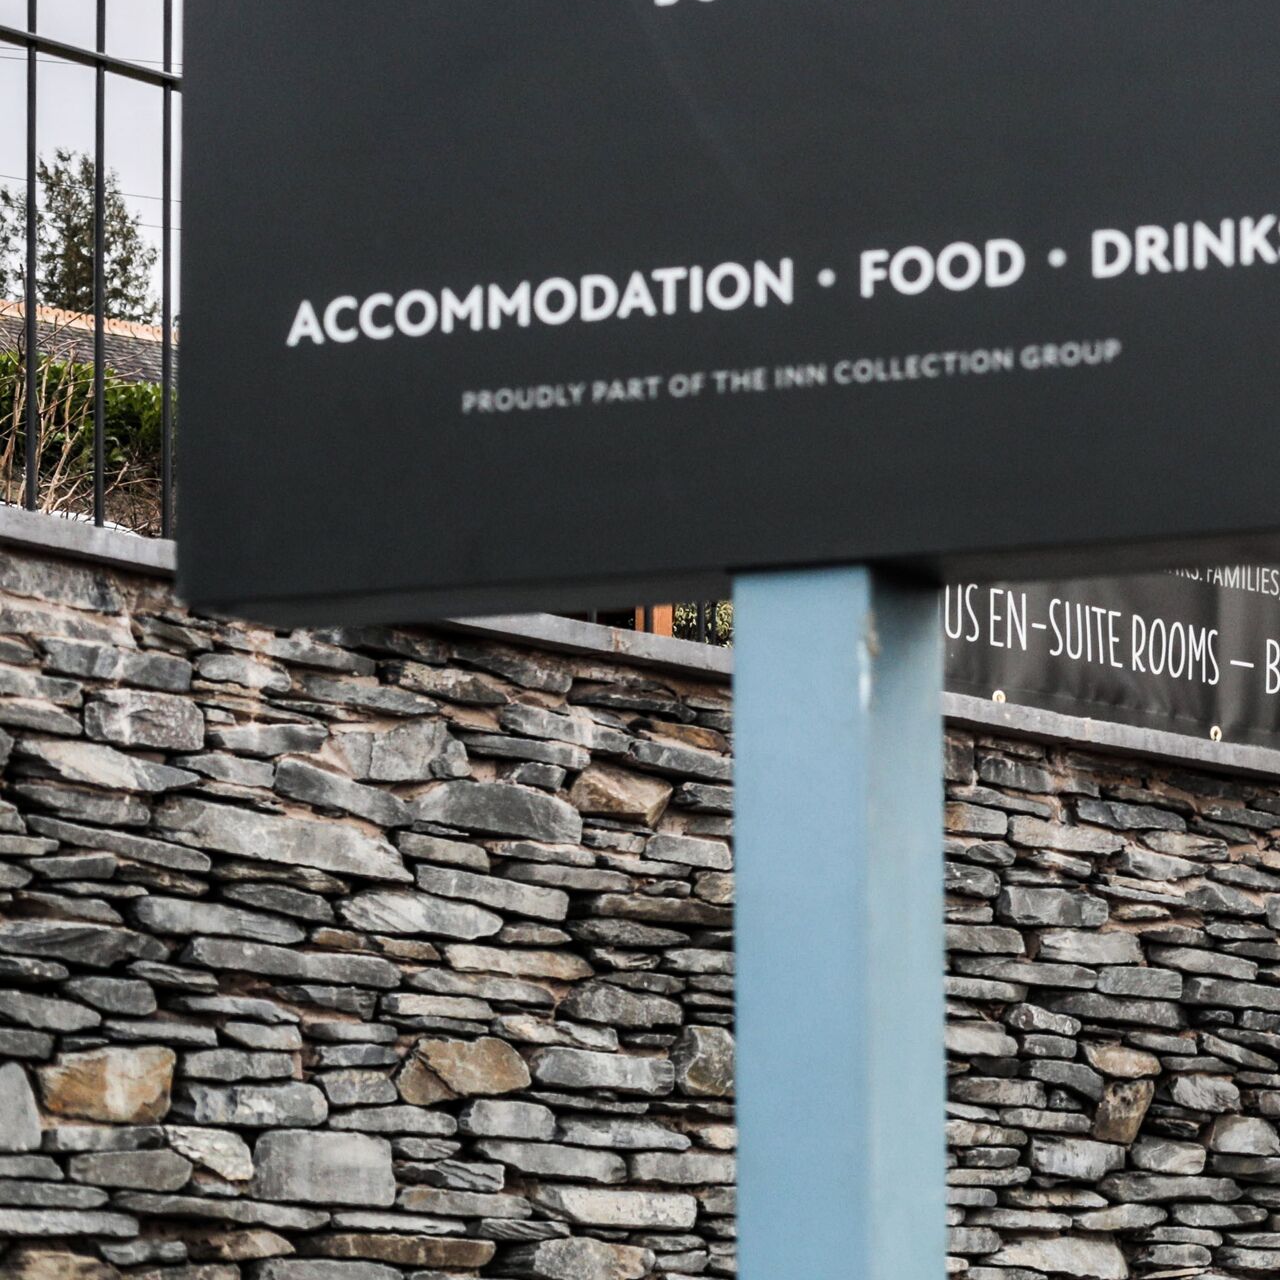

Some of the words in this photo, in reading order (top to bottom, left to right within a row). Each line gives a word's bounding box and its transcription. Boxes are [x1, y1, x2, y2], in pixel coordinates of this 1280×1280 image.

[286, 257, 794, 348] ACCOMMODATION
[859, 238, 1026, 299] FOOD
[461, 381, 585, 415] PROUDLY
[591, 375, 662, 404] PART
[667, 371, 706, 398] OF
[712, 366, 768, 394] THE
[773, 361, 828, 389] INN
[833, 346, 1014, 385] COLLECTION
[1020, 337, 1123, 371] GROUP
[989, 588, 1123, 669] EN-SUITE
[1132, 614, 1220, 686] ROOMS
